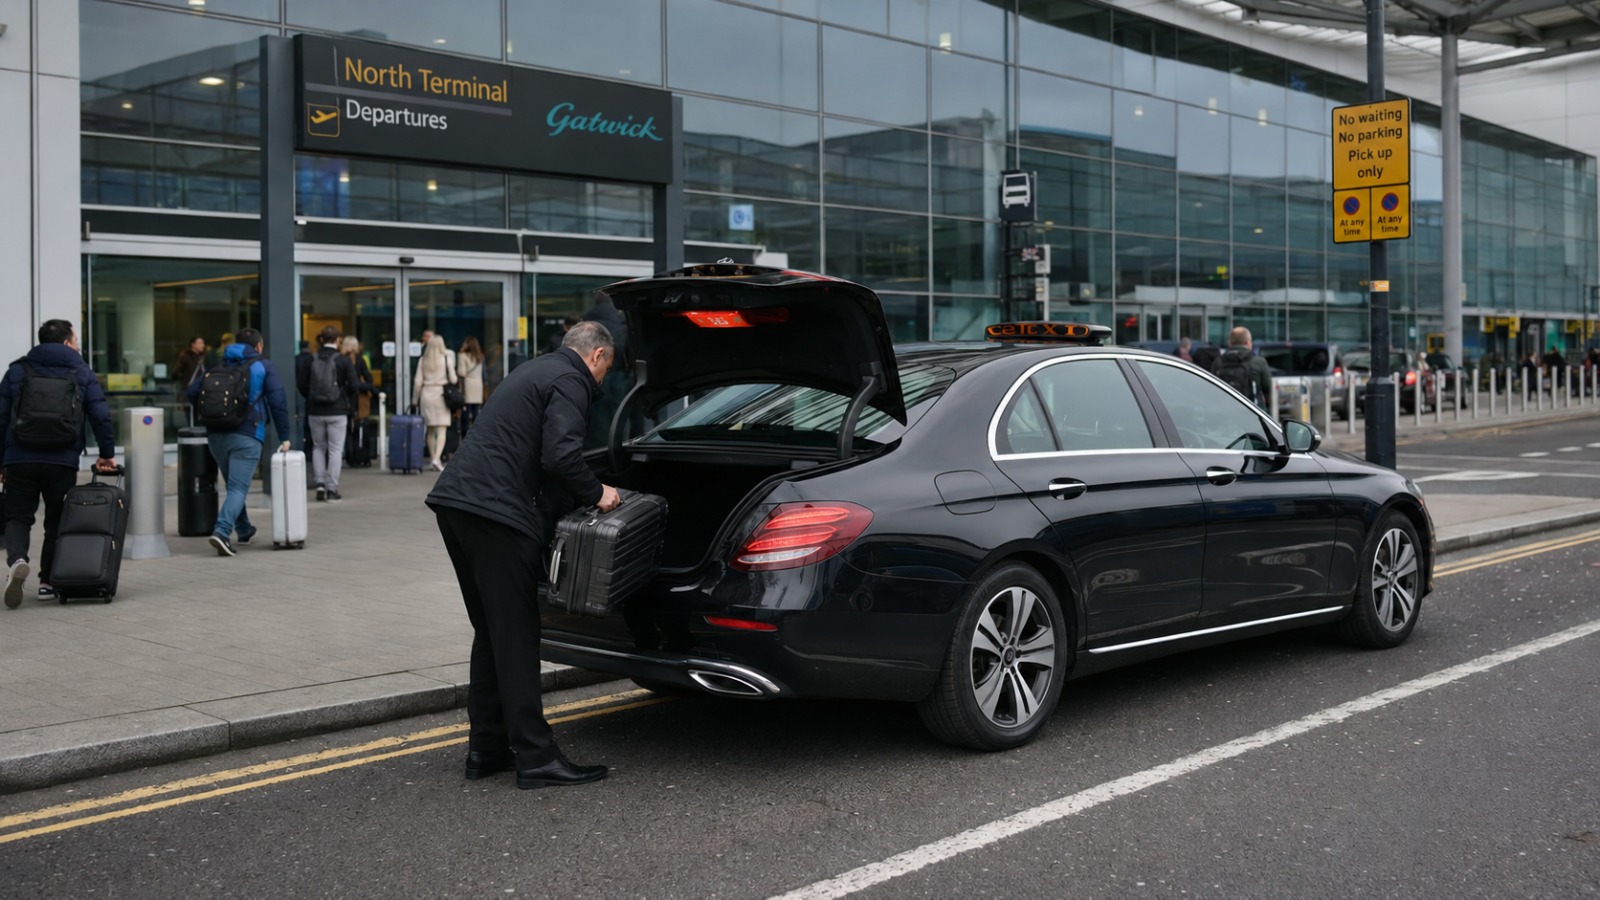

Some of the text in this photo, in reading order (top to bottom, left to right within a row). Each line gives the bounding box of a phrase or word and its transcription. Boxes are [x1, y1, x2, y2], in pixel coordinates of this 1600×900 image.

[344, 57, 508, 103] North Terminal
[346, 99, 448, 130] Departures
[546, 102, 664, 141] Gatwick
[1339, 109, 1402, 126] No waiting
[1339, 127, 1402, 143] No parking
[1348, 148, 1393, 162] Pick up
[1357, 165, 1384, 179] only
[1340, 218, 1365, 227] At any
[1377, 215, 1403, 224] At any
[1343, 228, 1361, 236] time
[1381, 224, 1399, 233] time
